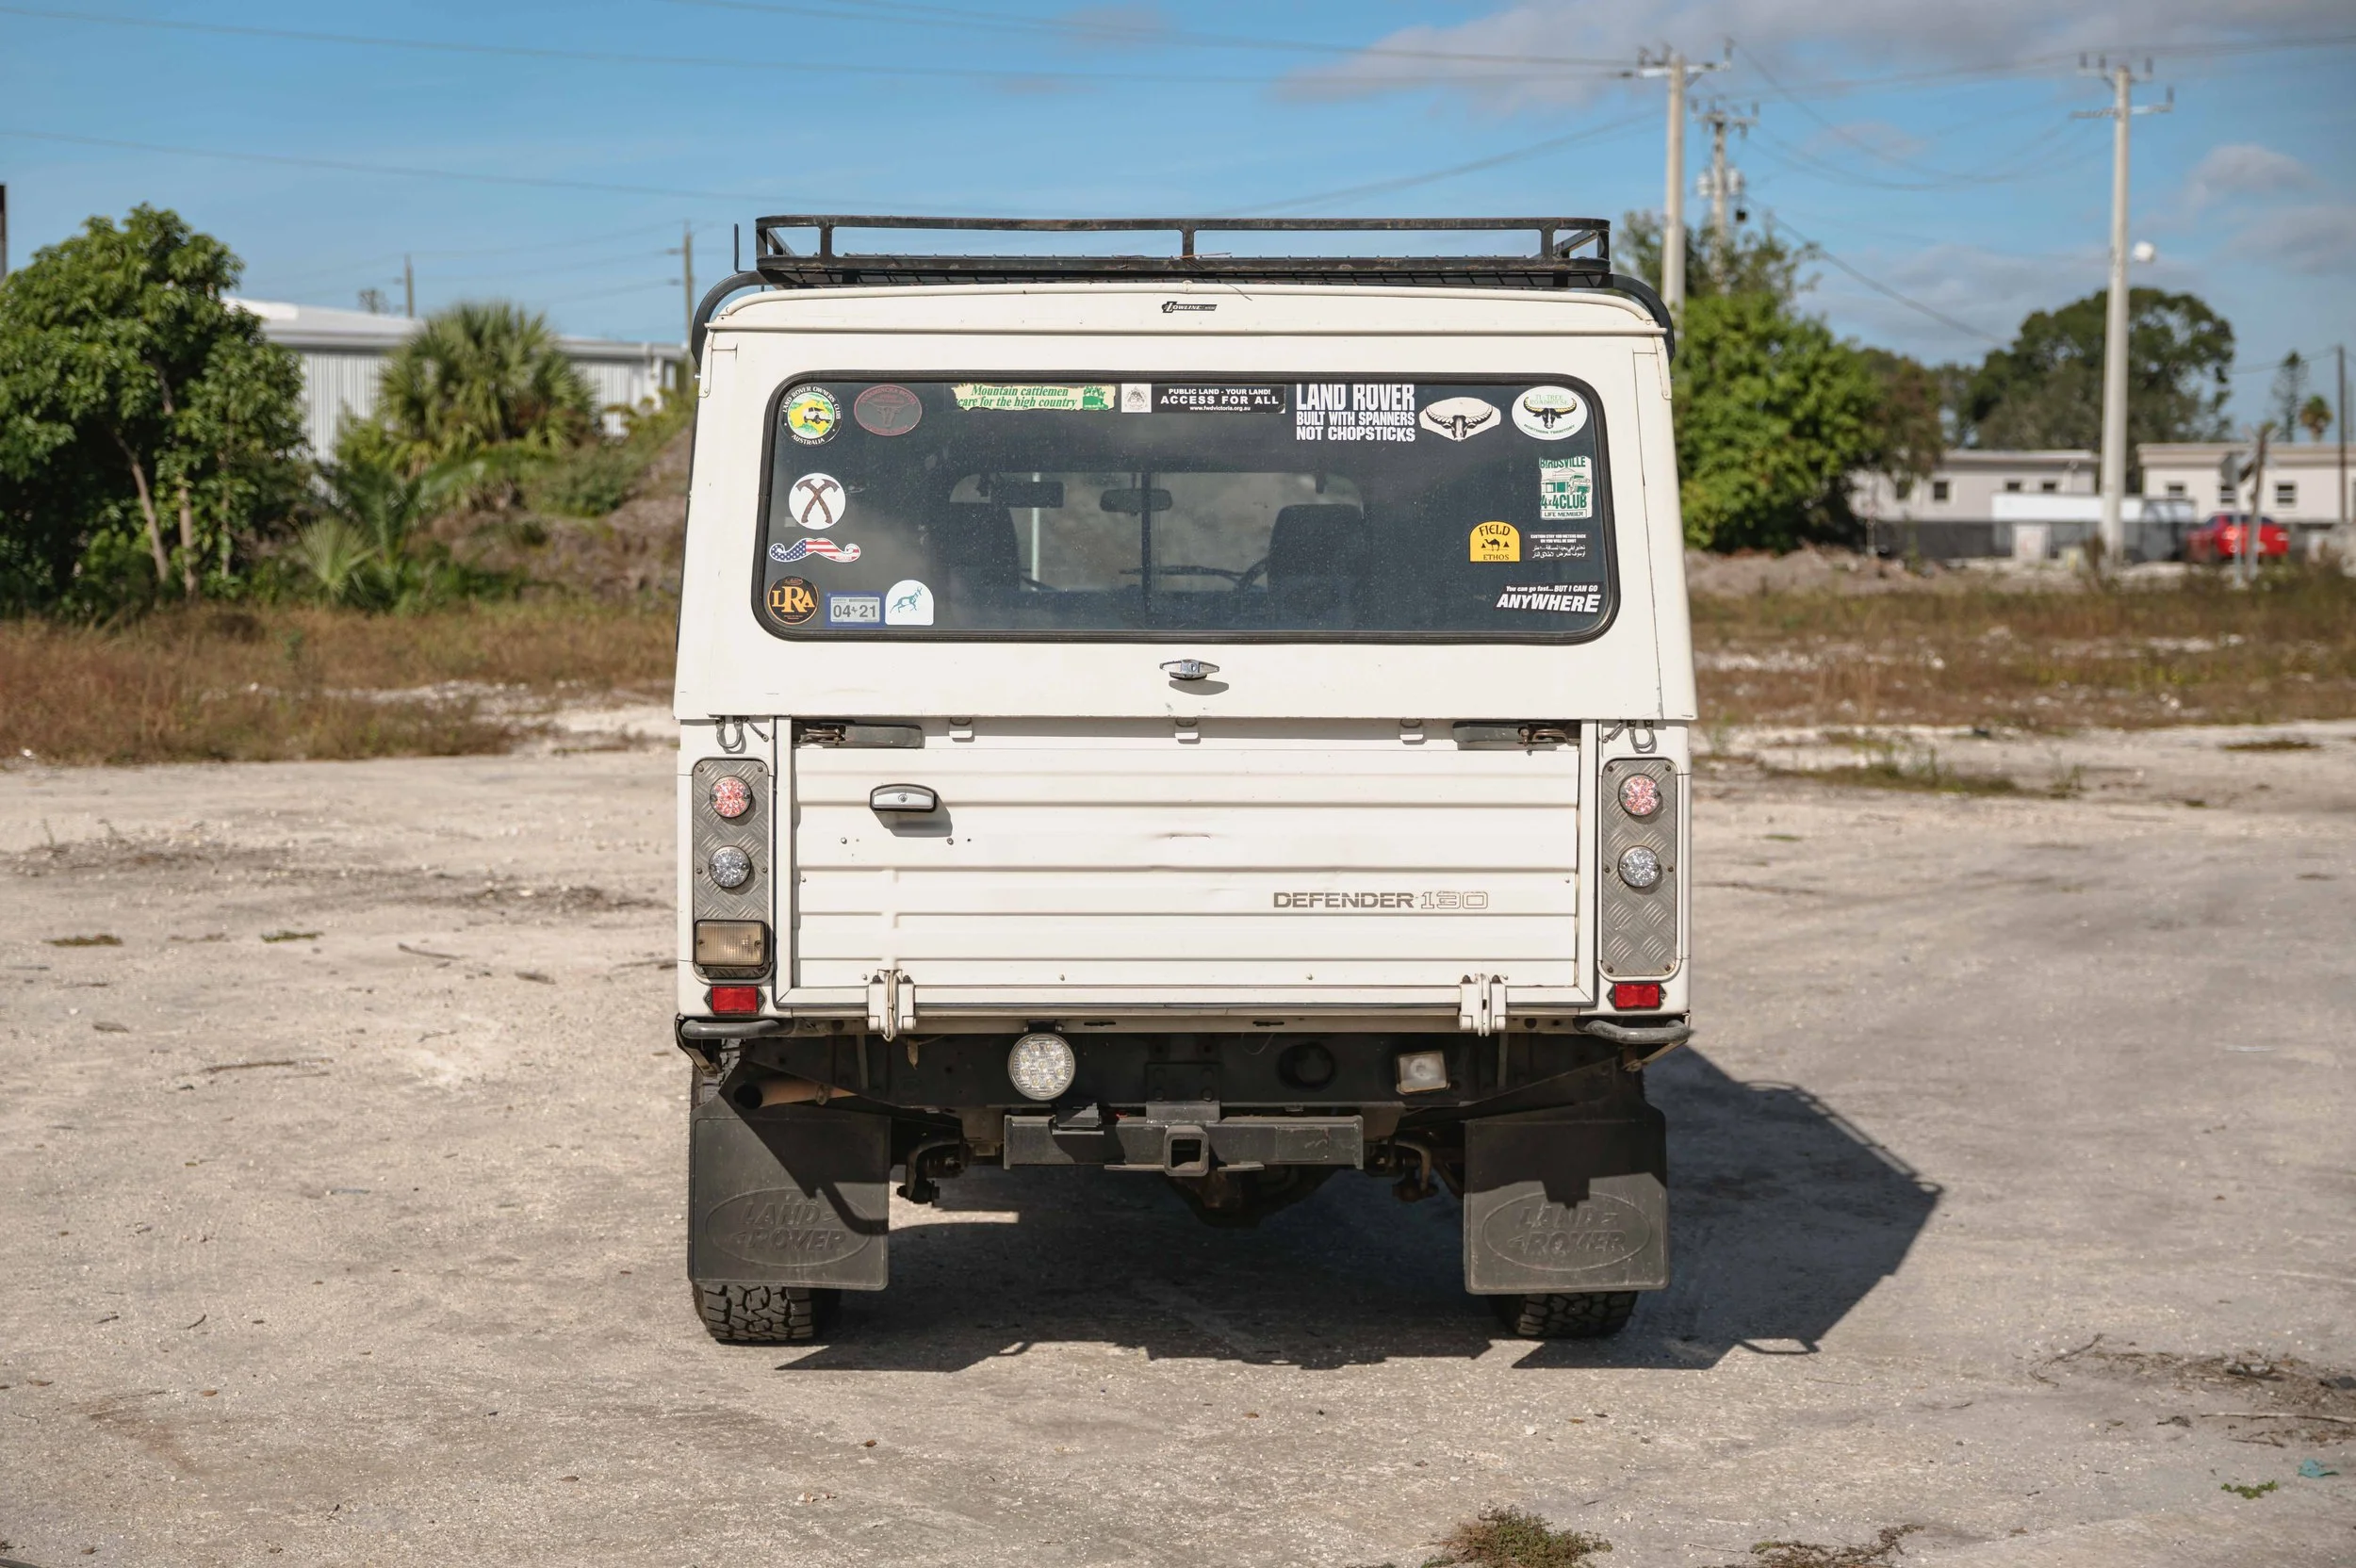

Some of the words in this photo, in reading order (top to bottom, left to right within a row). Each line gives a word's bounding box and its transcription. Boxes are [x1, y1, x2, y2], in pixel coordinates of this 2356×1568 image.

[971, 385, 1018, 396] Mountain
[1021, 386, 1069, 396] cattlemen
[1296, 384, 1346, 410] LAND
[1353, 384, 1415, 411] ROVER
[782, 397, 793, 413] LAND
[792, 386, 811, 397] ROVER
[812, 386, 836, 402] OWNERS
[833, 403, 842, 419] CLUB
[957, 398, 978, 407] care
[980, 396, 994, 406] for
[996, 397, 1011, 406] the
[1014, 397, 1036, 408] high
[1039, 398, 1077, 409] country
[1160, 396, 1216, 404] ACCESS
[1221, 396, 1249, 404] FOR
[1254, 396, 1279, 404] ALL
[1296, 412, 1325, 426] BUILT
[1329, 412, 1356, 426] WITH
[1358, 412, 1415, 426] SPANNERS
[1296, 427, 1324, 441] NOT
[1327, 427, 1415, 442] CHOPSTICKS
[1524, 424, 1548, 434] NORTHERN
[1550, 424, 1575, 434] TERRITORY
[792, 434, 825, 445] AUSTRALIA
[1540, 457, 1586, 468] BIRDSVILLE
[1479, 524, 1511, 536] FIELD
[772, 586, 815, 612] LRA
[1497, 594, 1601, 612] ANYWHERE
[833, 605, 851, 617] 04
[859, 605, 875, 617] 21
[1273, 892, 1414, 908] DEFENDER
[1420, 890, 1489, 909] 130
[740, 1202, 821, 1225] LAND
[1515, 1204, 1597, 1228] LAND
[746, 1227, 846, 1251] ROVER
[1524, 1230, 1627, 1255] ROVER
